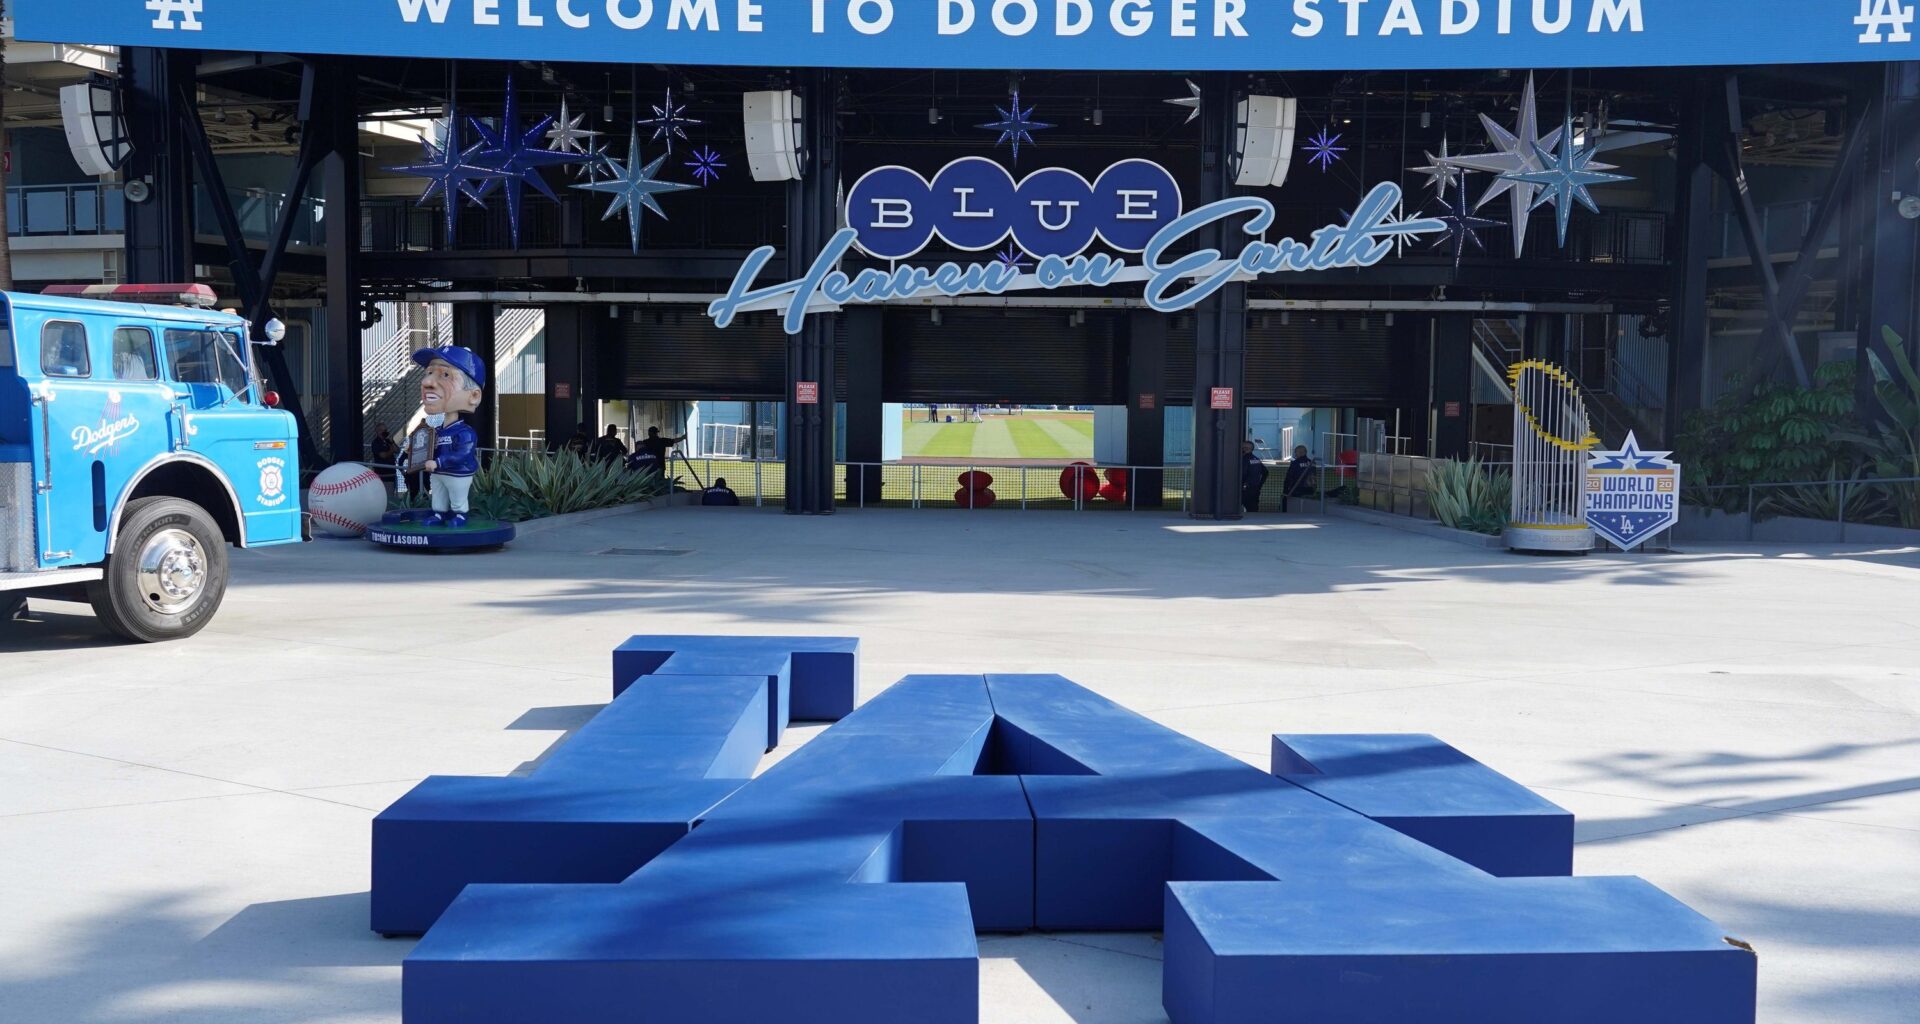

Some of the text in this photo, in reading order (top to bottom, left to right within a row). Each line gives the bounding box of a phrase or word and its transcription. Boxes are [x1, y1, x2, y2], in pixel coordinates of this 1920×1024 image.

[937, 0, 1249, 37] DODGER
[1290, 0, 1644, 37] STADIUM
[869, 187, 1158, 231] BLUE
[708, 181, 1449, 334] Heaven on Earth
[71, 412, 140, 454] Dodgers
[256, 456, 285, 469] DODGER
[1603, 476, 1655, 492] WORLD
[1586, 493, 1674, 509] CHAMPIONS
[1620, 514, 1634, 534] LA
[371, 531, 429, 545] TOMMY LASORDA
